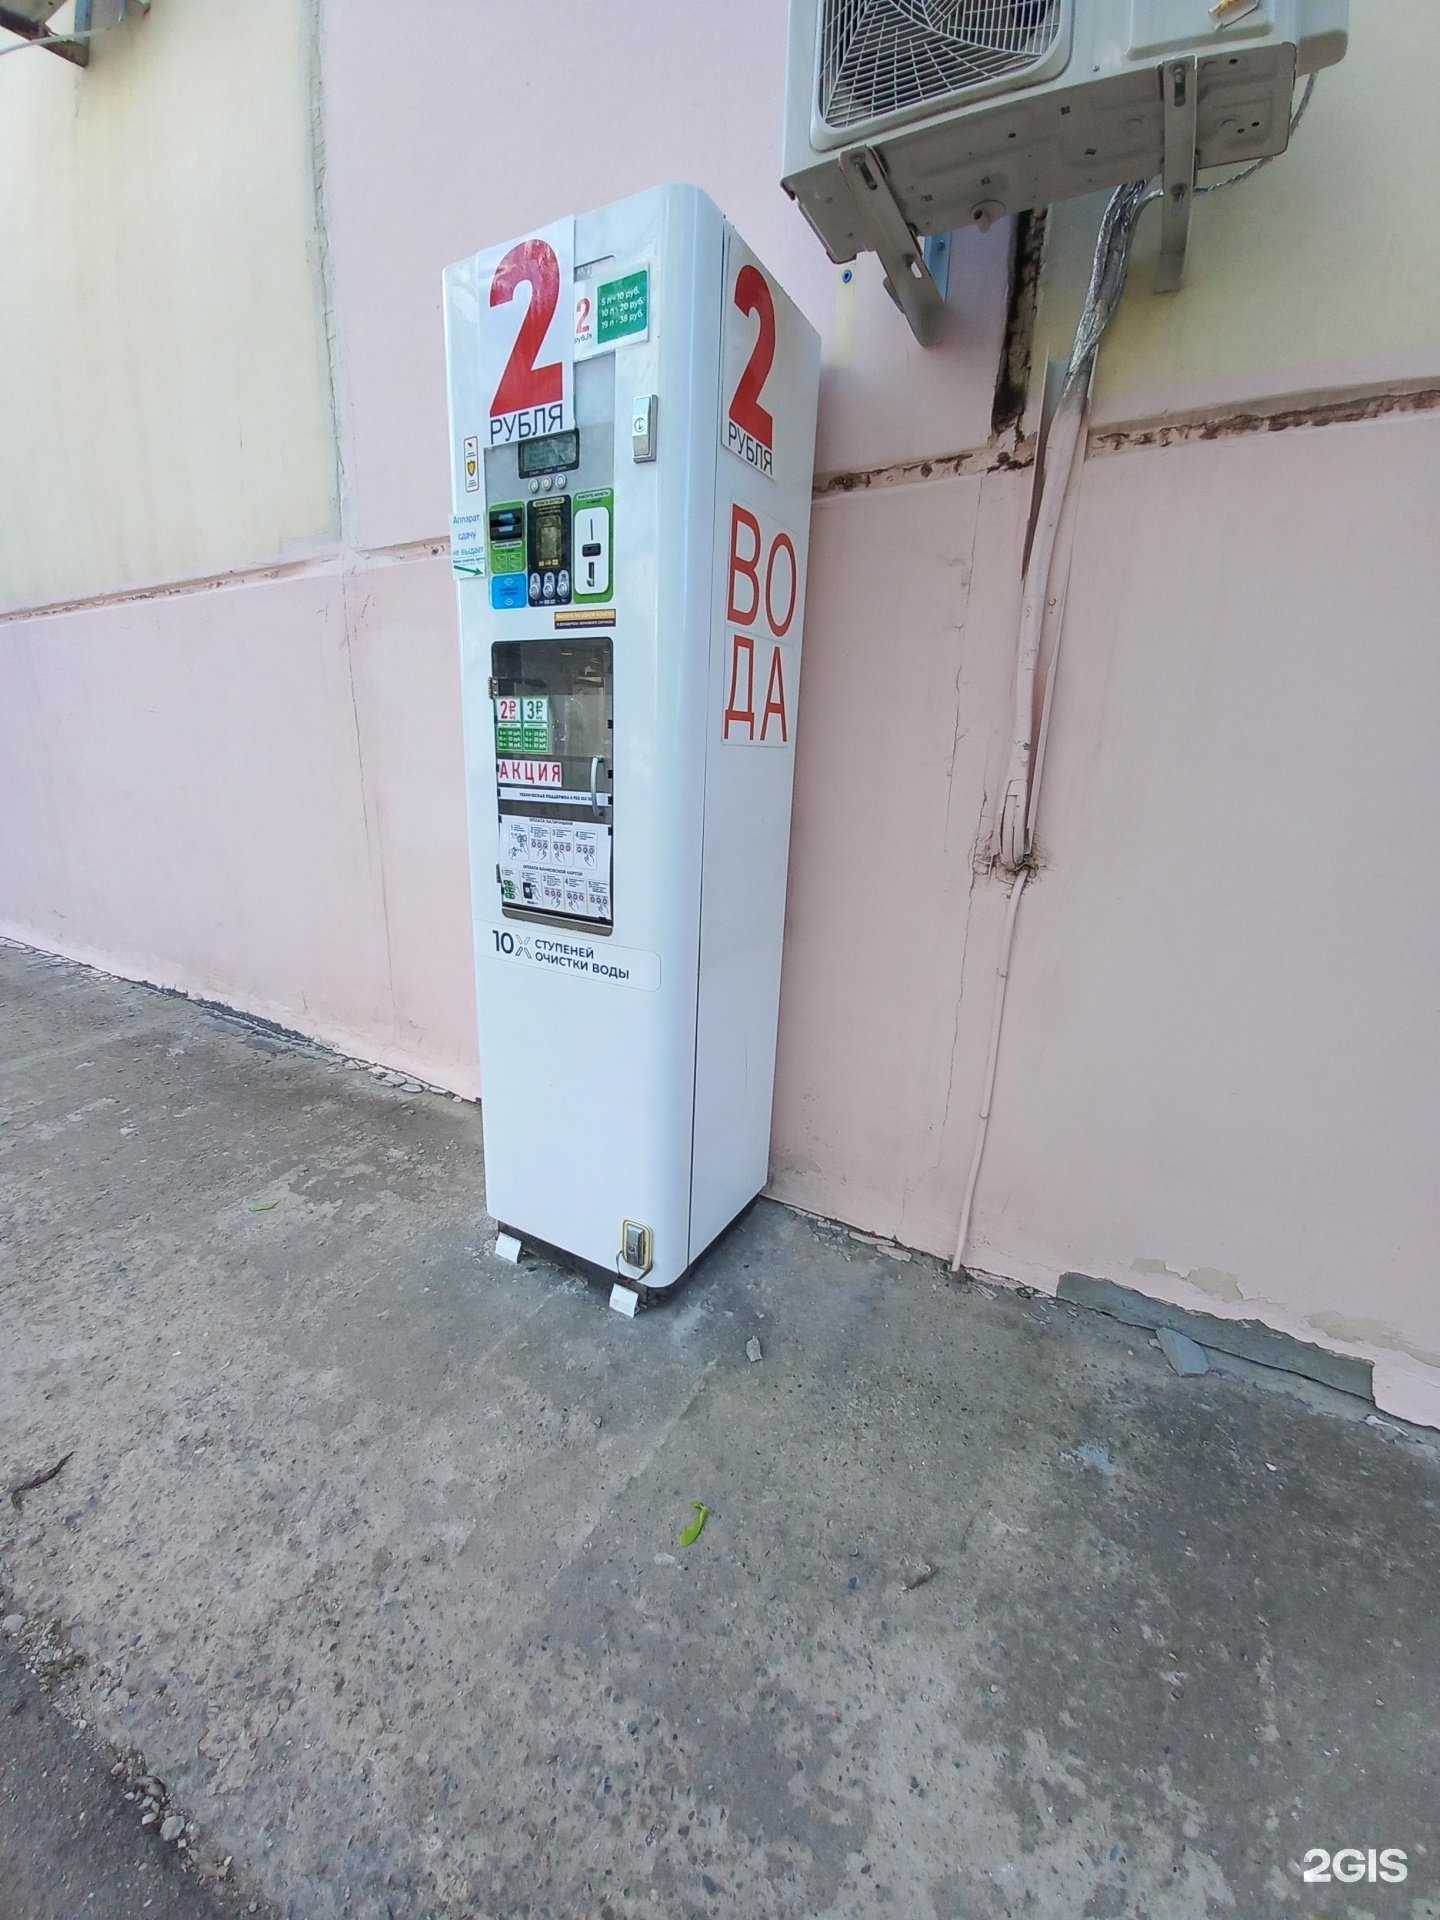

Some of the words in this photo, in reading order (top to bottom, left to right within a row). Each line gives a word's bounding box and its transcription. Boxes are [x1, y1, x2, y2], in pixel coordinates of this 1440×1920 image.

[617, 291, 625, 300] 10
[620, 303, 629, 312] 20
[489, 238, 564, 418] 2
[576, 297, 591, 334] 2
[728, 264, 776, 450] 2
[490, 404, 564, 445] РУБЛЯ
[728, 421, 774, 476] РУБЛЯ
[727, 503, 797, 637] ВО
[723, 634, 788, 742] ДА
[500, 761, 561, 784] АКЦИЯ
[534, 938, 594, 959] СТУПЕНЕЙ
[535, 951, 588, 971] ОЧИСТКИ
[592, 962, 629, 980] ВОДЫ
